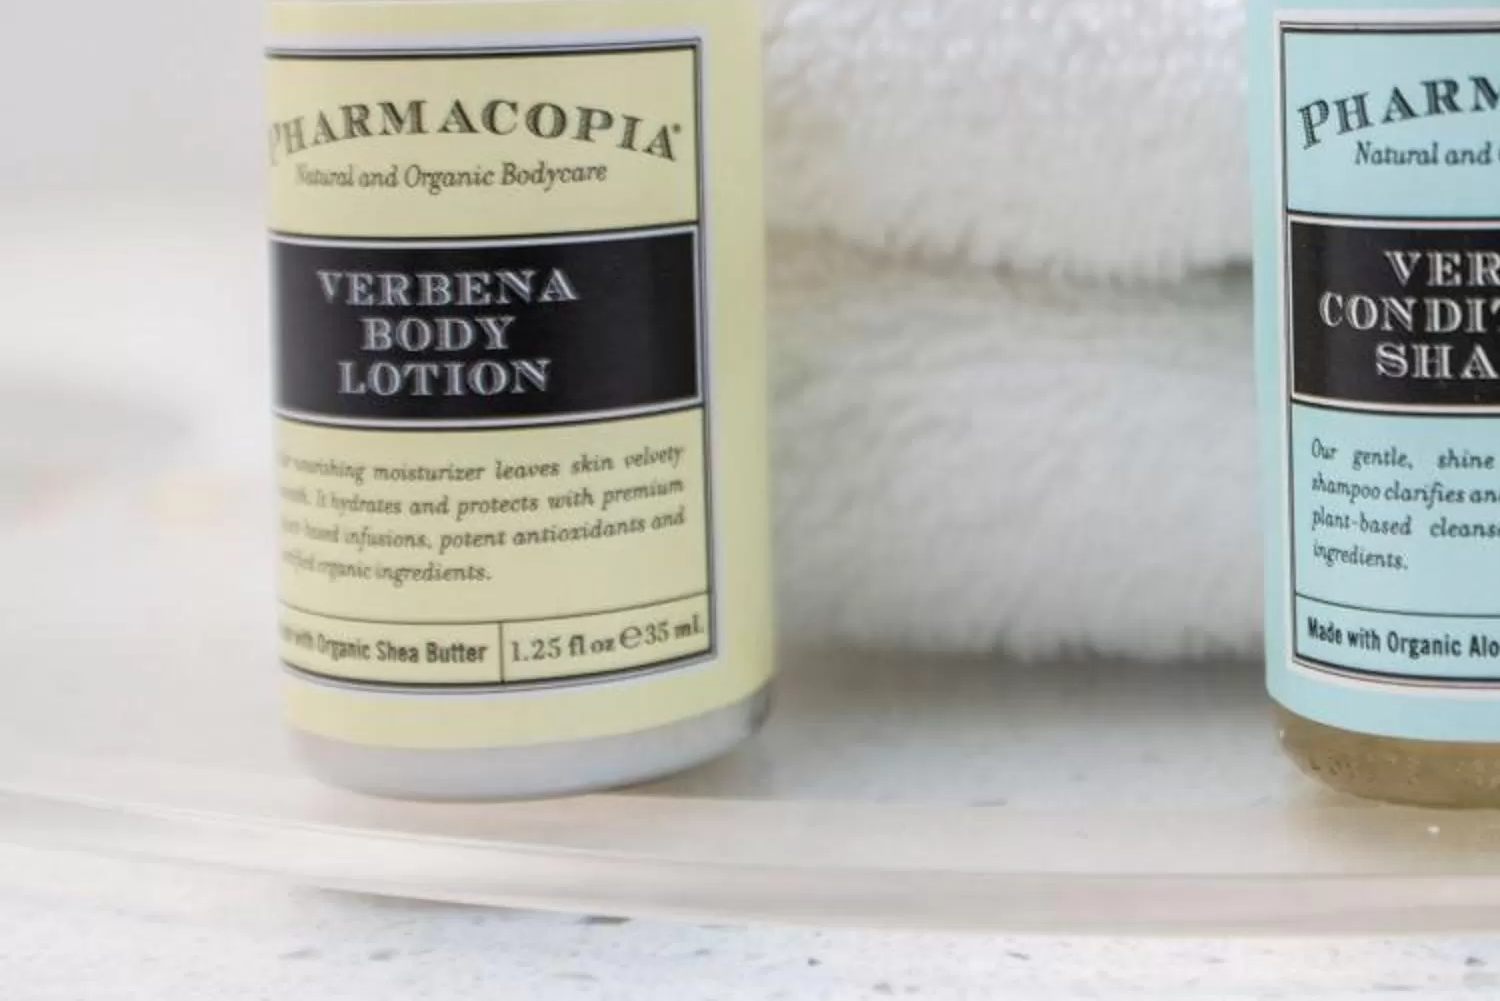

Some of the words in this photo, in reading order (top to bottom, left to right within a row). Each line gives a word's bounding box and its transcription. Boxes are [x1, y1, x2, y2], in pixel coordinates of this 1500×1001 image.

[1354, 140, 1439, 166] Natural
[1445, 140, 1493, 166] and
[358, 163, 399, 187] and
[404, 164, 494, 195] Organic
[501, 161, 607, 193] Bodycare
[317, 268, 578, 306] VERBENA
[361, 315, 516, 351] BODY
[338, 358, 552, 396] LOTION
[373, 462, 485, 481] moisturizer
[495, 459, 560, 480] leaves
[570, 454, 614, 475] skin
[624, 446, 684, 469] velvety
[1311, 437, 1338, 460] Our
[1352, 446, 1413, 471] gentle,
[1437, 447, 1495, 470] shine
[330, 490, 402, 517] hydrates
[409, 495, 449, 515] and
[455, 495, 538, 522] protects
[548, 487, 594, 511] with
[601, 478, 684, 511] premium
[1311, 471, 1381, 505] shampoo
[1383, 480, 1465, 511] clarifies
[438, 529, 506, 555] potent
[512, 518, 645, 546] antioxidants
[651, 504, 685, 530] and
[1311, 505, 1412, 536] plant-based
[1312, 540, 1408, 570] ingredients.
[375, 560, 492, 588] ingredients.
[317, 632, 371, 662] Organic
[376, 639, 420, 663] Shea
[425, 641, 488, 664] Butter
[511, 635, 562, 662] 1.25
[568, 633, 585, 657] fl
[590, 637, 616, 653] oz
[1307, 615, 1343, 644] Made
[1347, 627, 1382, 653] with
[1387, 630, 1463, 659] Organic
